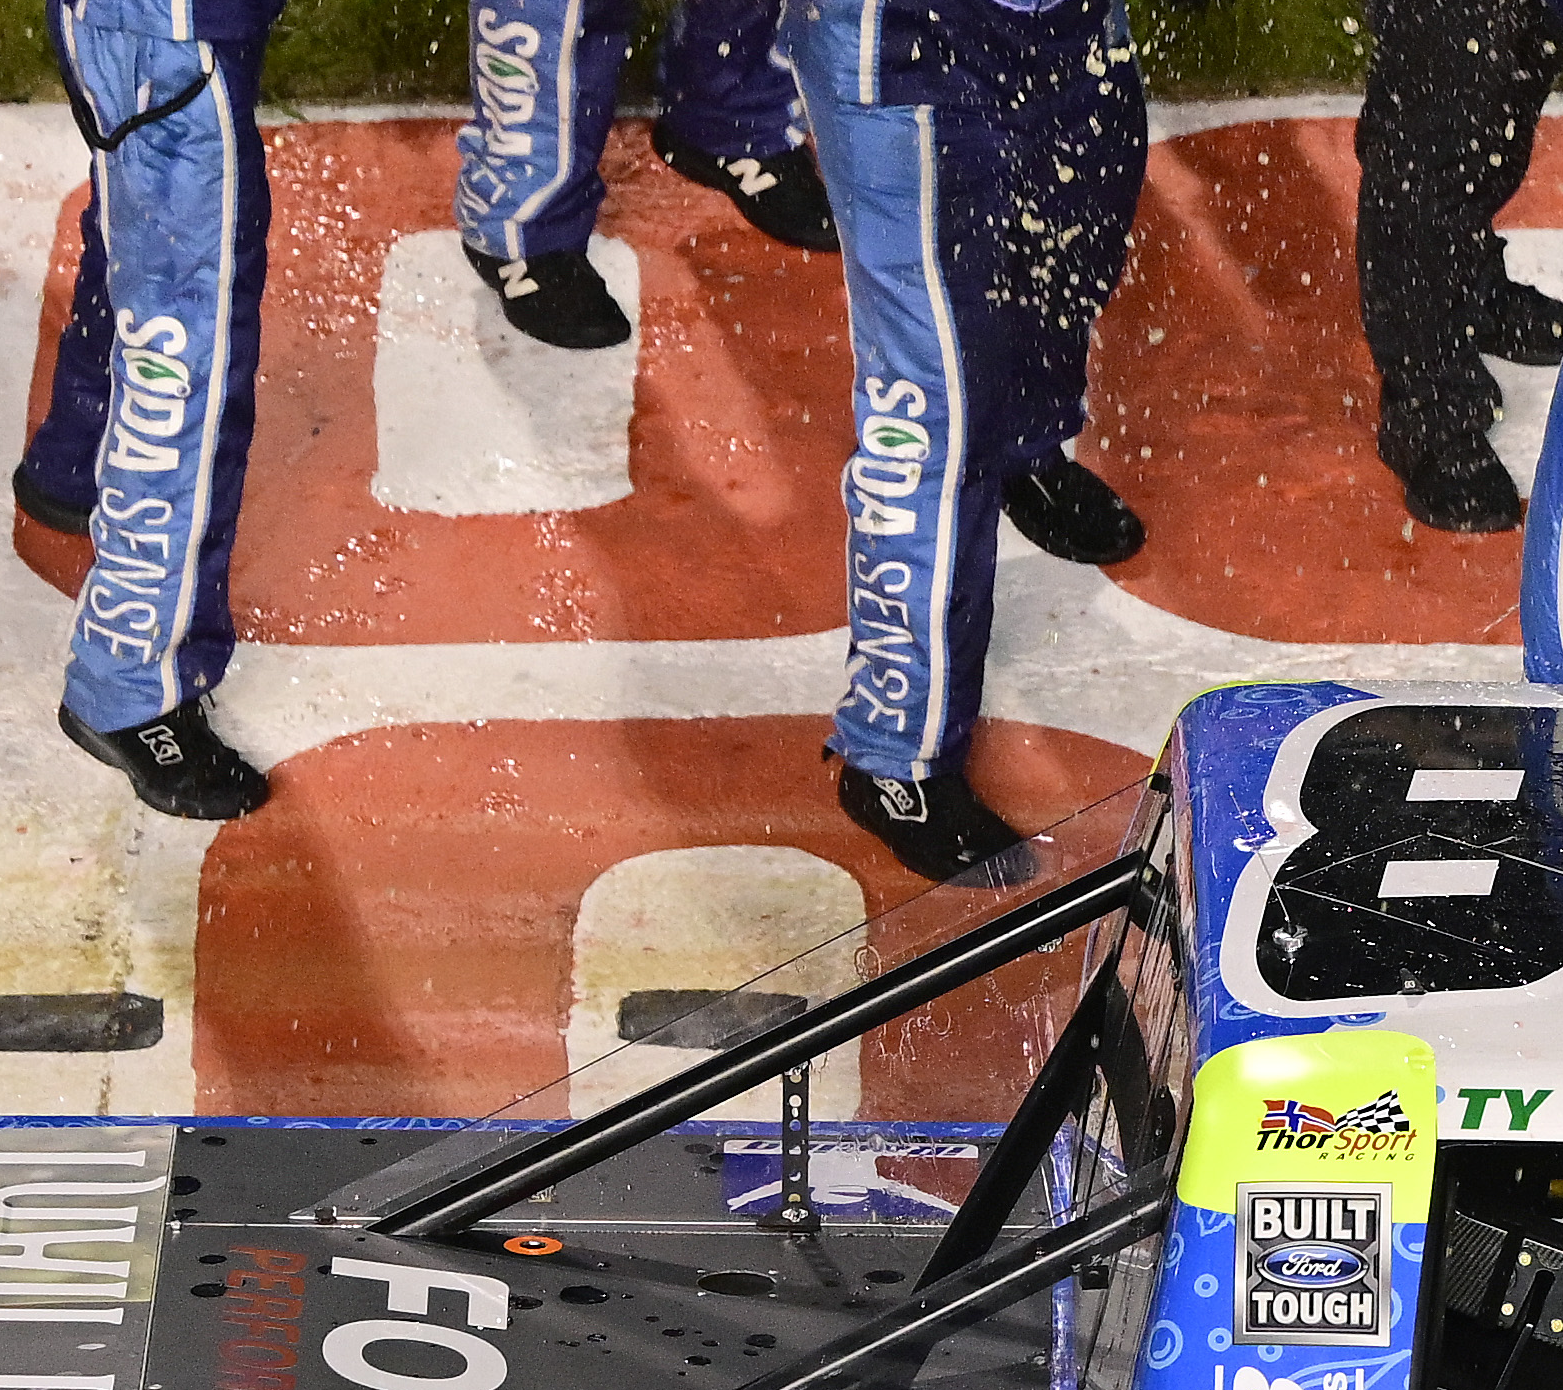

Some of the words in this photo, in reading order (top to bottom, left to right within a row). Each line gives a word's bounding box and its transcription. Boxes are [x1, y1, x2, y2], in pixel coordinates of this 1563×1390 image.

[107, 308, 193, 473] SODA
[855, 376, 931, 538] SODA
[84, 488, 174, 666] SENSE
[853, 552, 915, 733] SENSE
[1456, 1087, 1552, 1133] TY
[1319, 1152, 1416, 1161] RACING
[1254, 1198, 1376, 1240] BUILT
[1281, 1250, 1342, 1277] Ford
[1252, 1291, 1374, 1326] TOUGH
